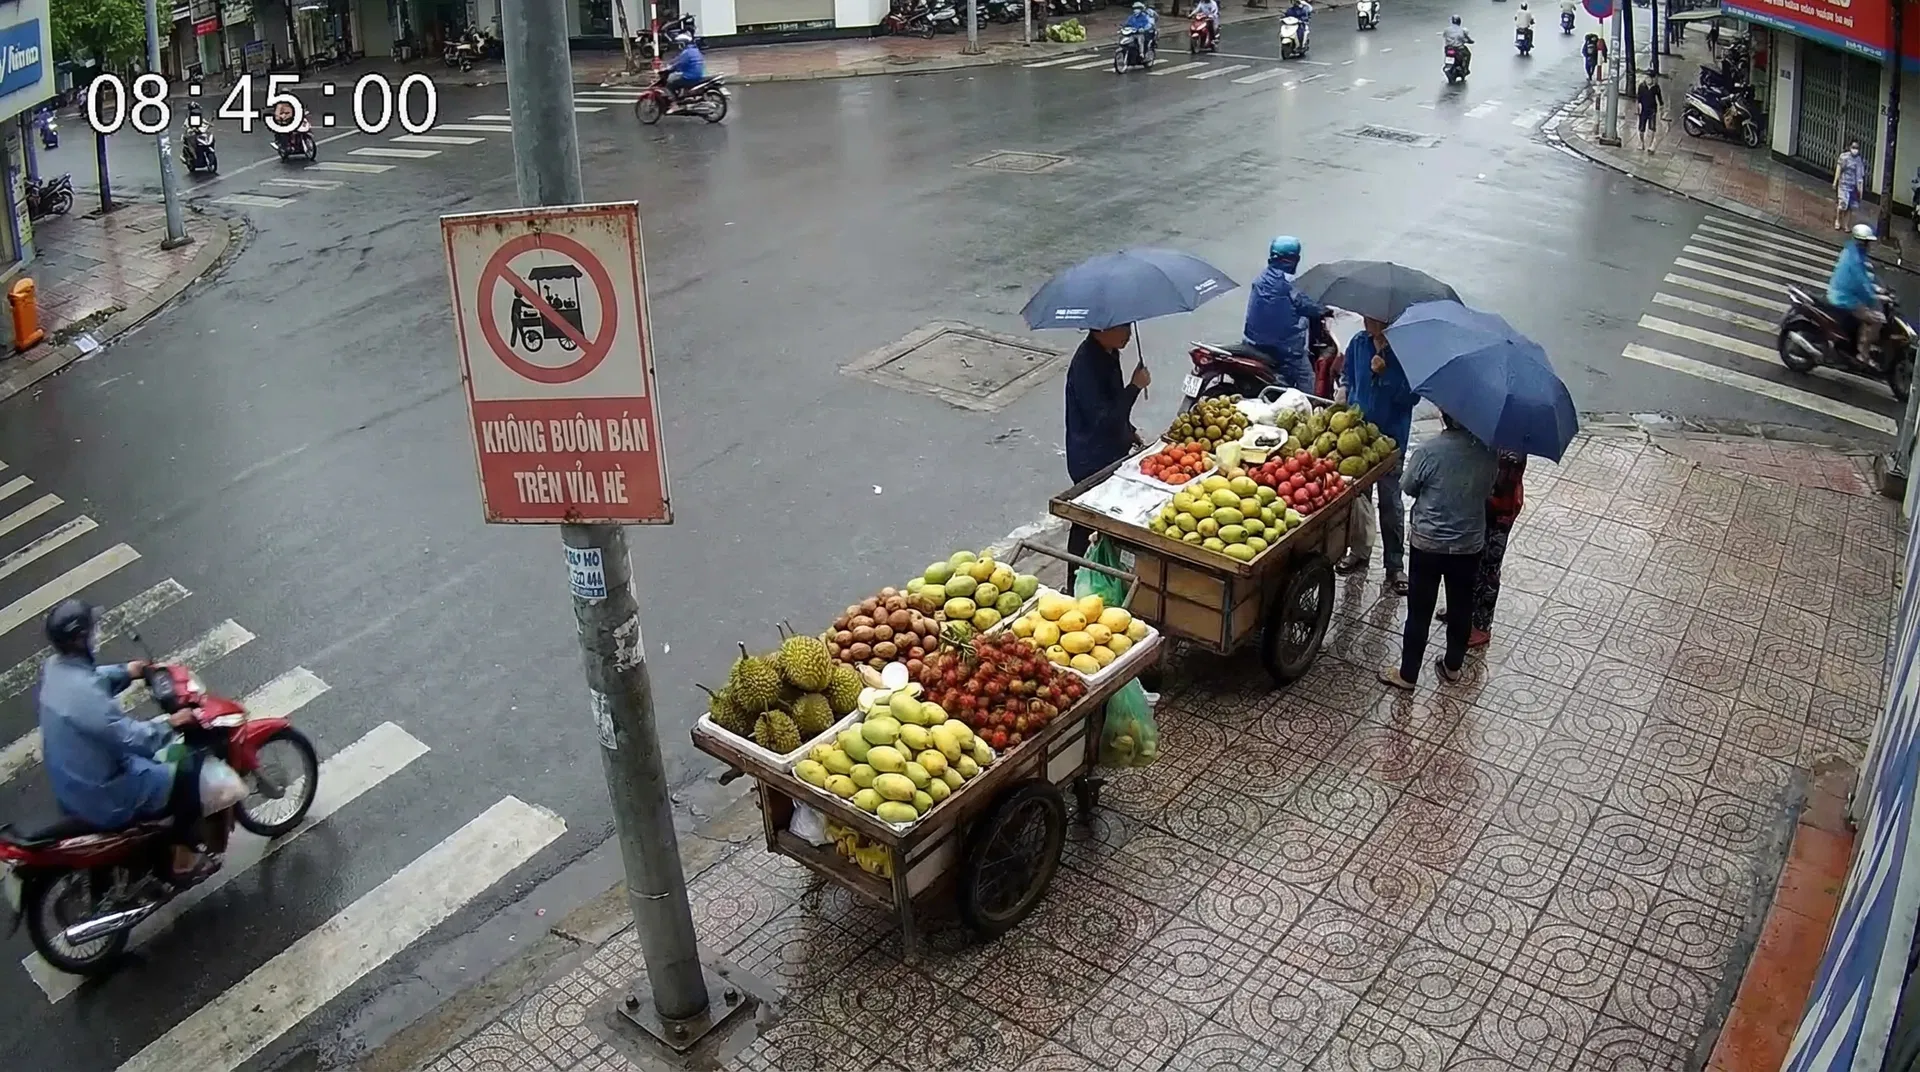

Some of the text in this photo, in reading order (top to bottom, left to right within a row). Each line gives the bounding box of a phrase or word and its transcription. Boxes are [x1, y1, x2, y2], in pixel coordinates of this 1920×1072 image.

[481, 410, 650, 453] KHÔNG BUÔN BÁN
[513, 459, 629, 504] TRÊN VỈA HÈ
